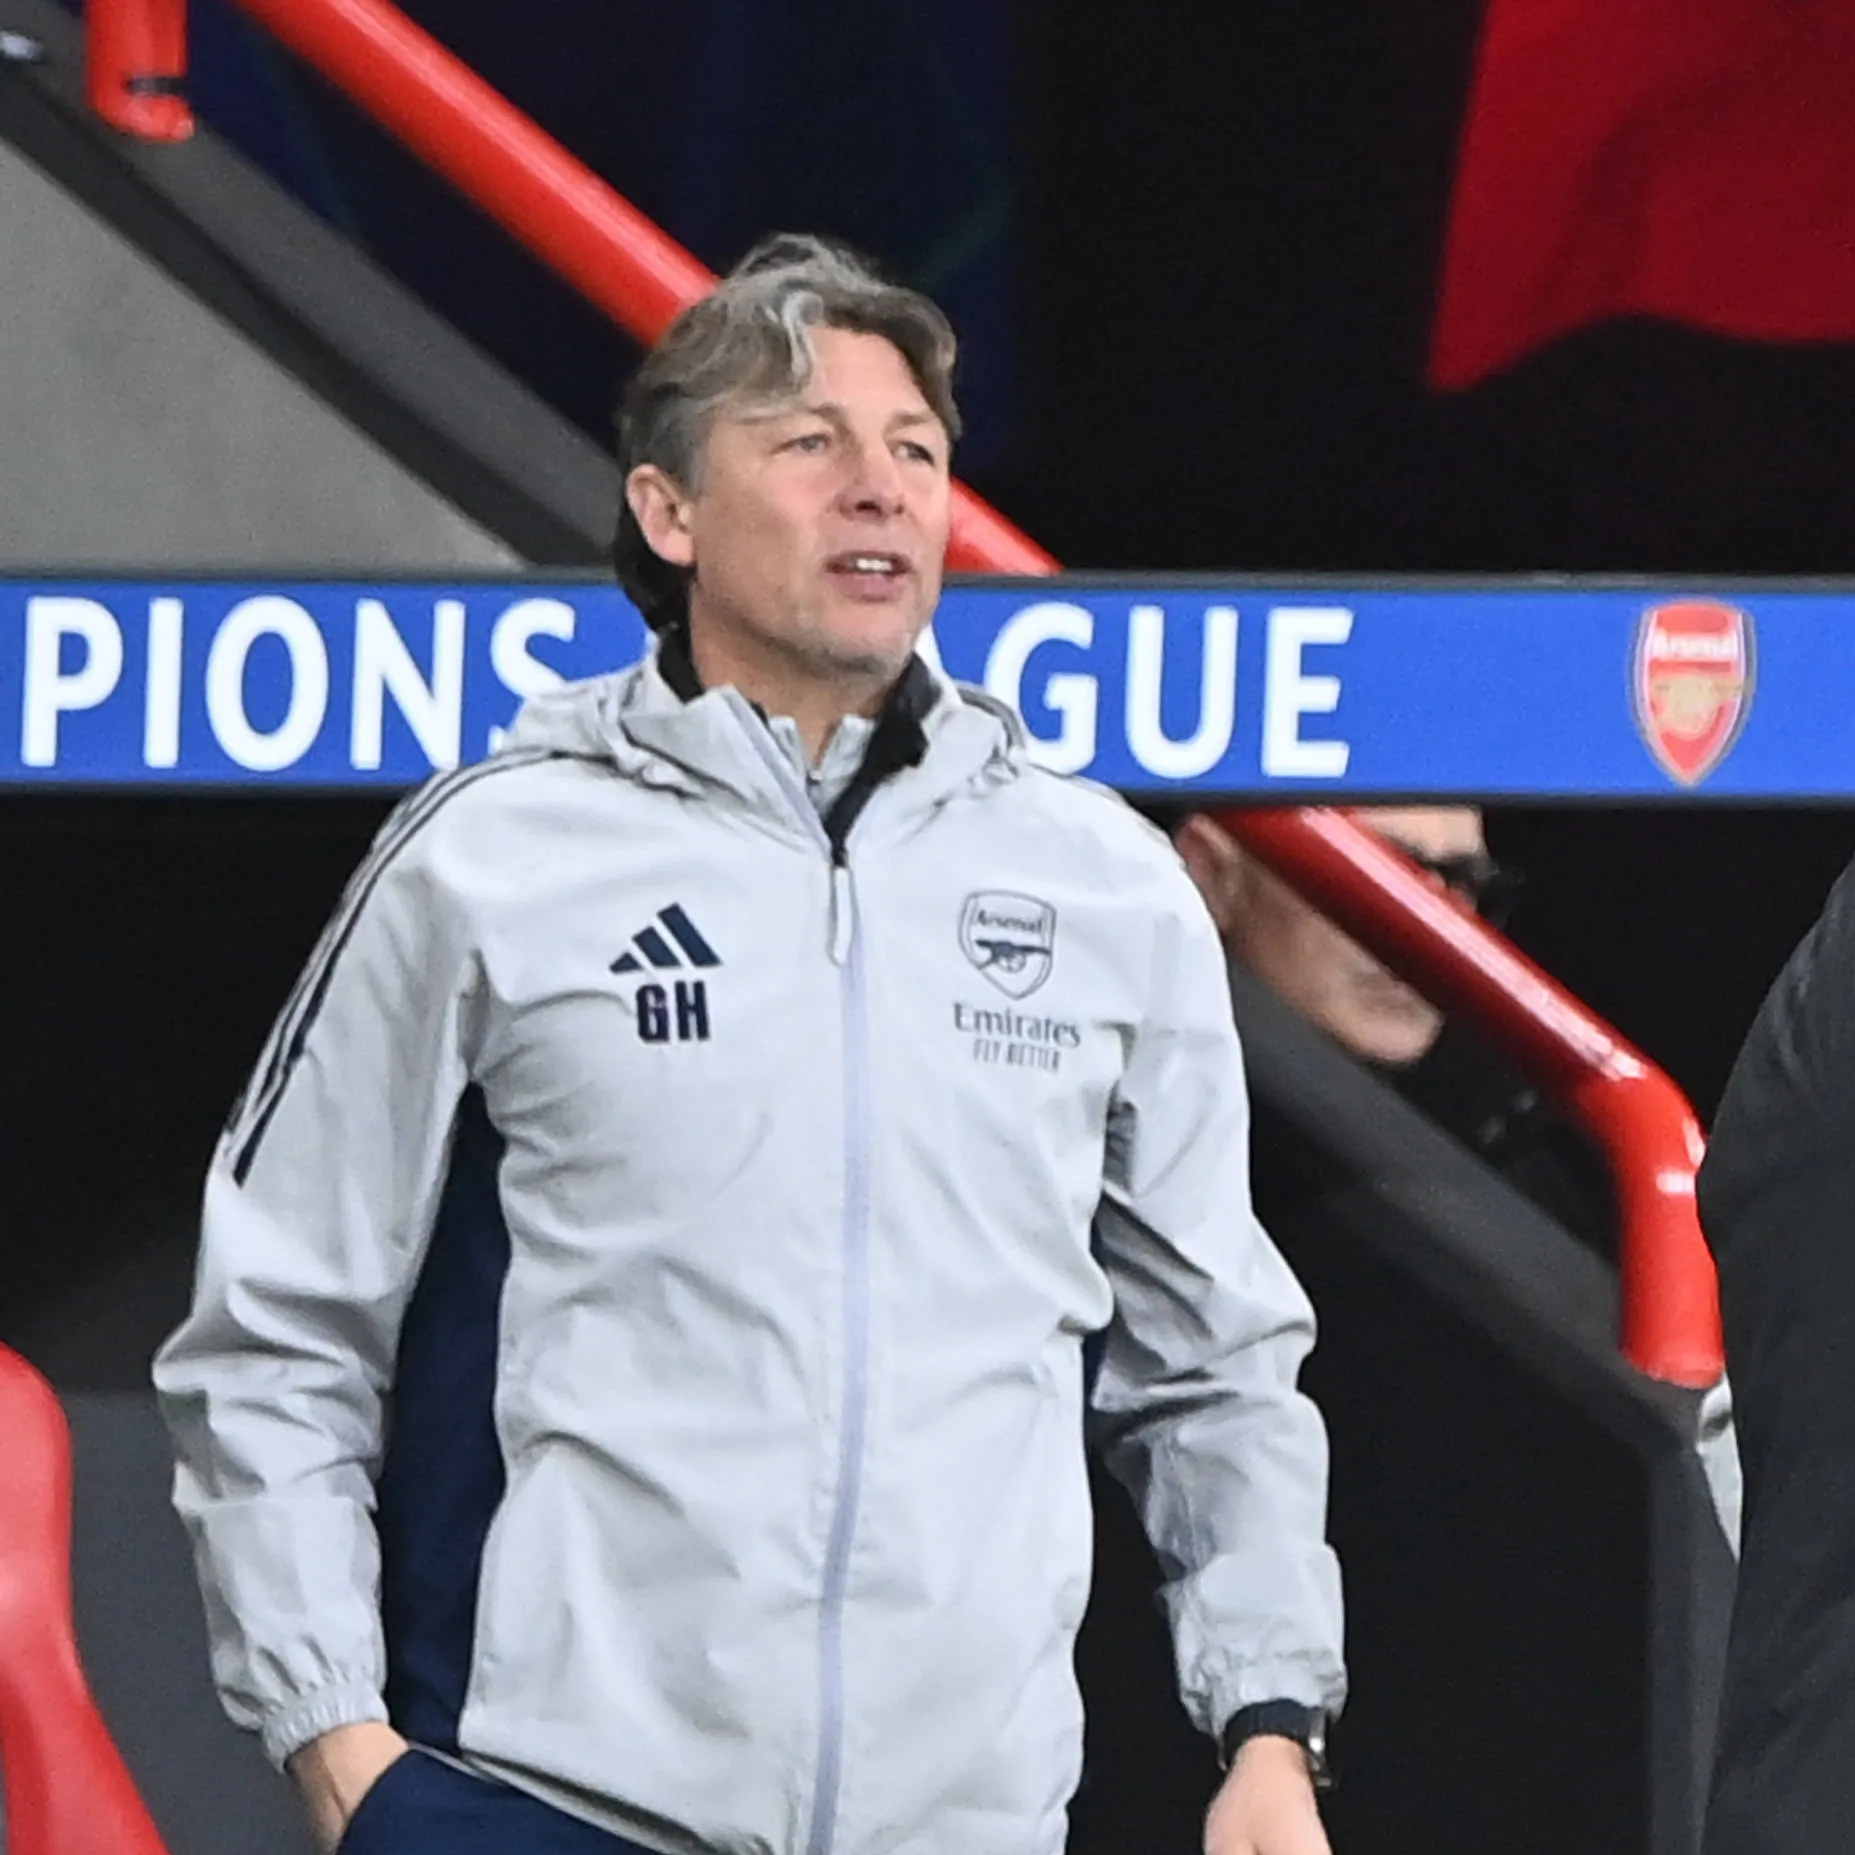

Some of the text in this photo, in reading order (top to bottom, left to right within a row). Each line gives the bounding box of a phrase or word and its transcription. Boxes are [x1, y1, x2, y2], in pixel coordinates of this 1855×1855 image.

[916, 601, 1354, 778] GUE
[635, 980, 711, 1044] GH
[954, 1001, 1081, 1049] Emirates
